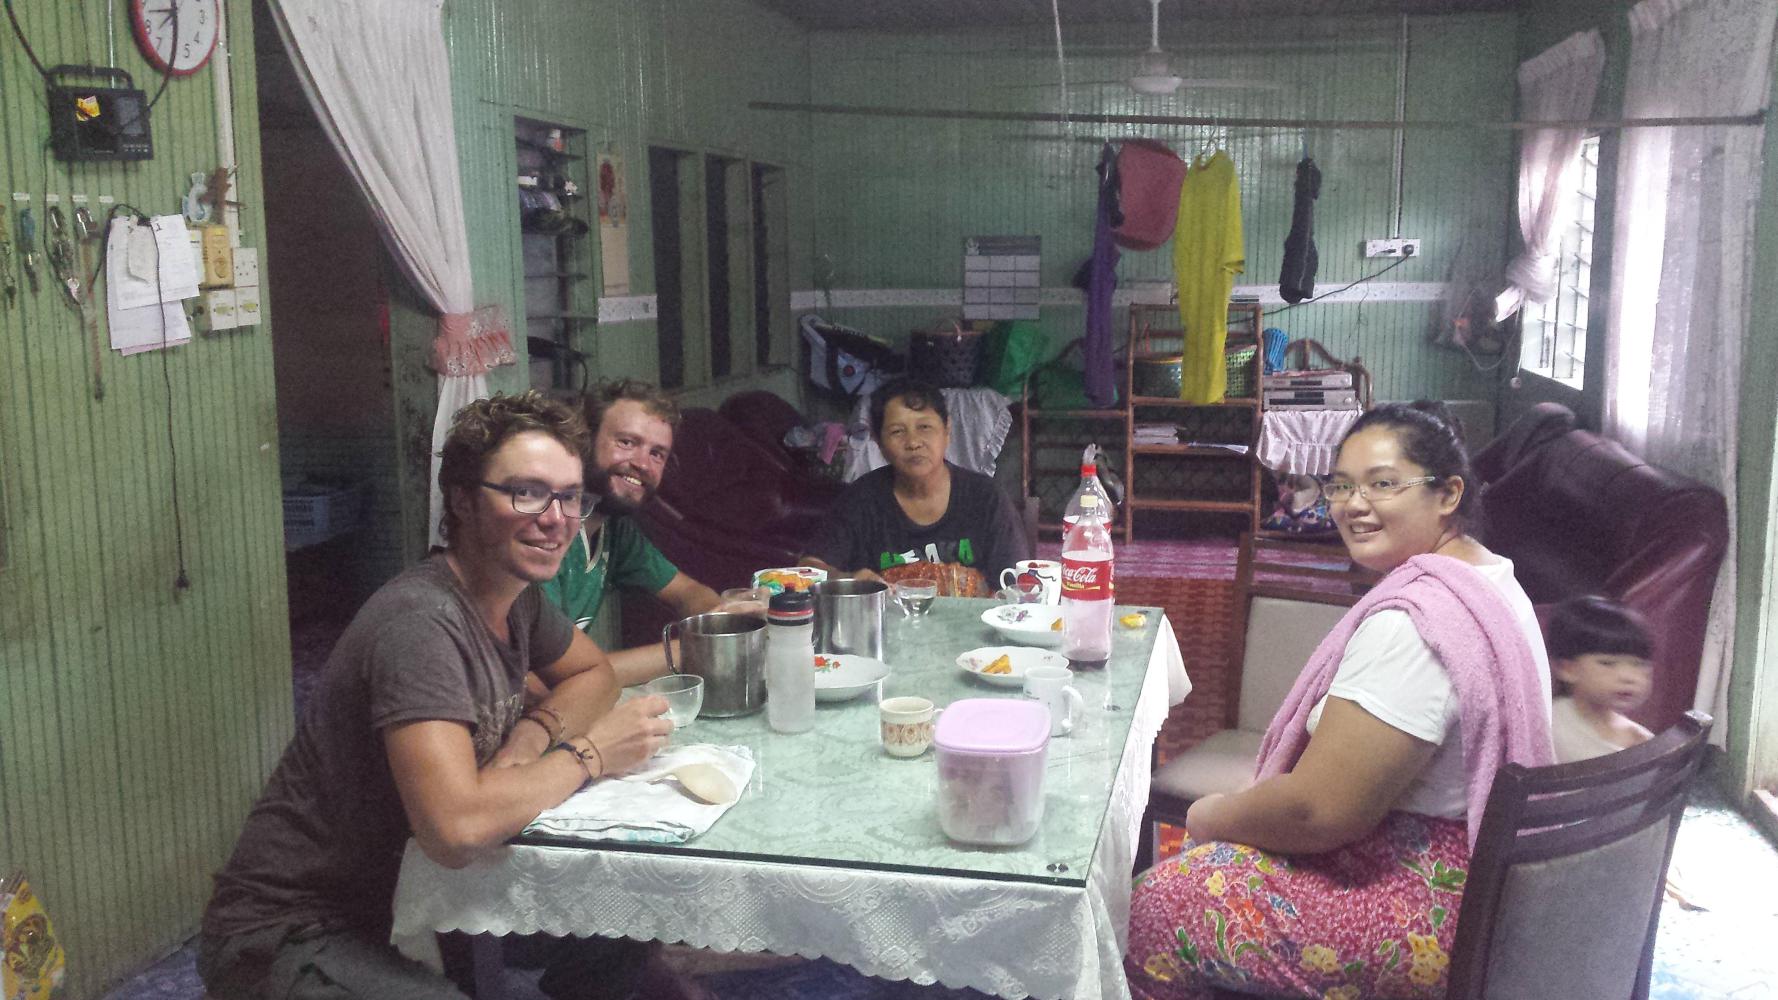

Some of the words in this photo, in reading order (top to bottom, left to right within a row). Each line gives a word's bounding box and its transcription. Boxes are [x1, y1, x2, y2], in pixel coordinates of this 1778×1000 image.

[199, 9, 205, 25] 3
[145, 19, 151, 35] 8
[155, 37, 161, 50] 7
[193, 31, 199, 44] 4
[184, 43, 190, 59] 5
